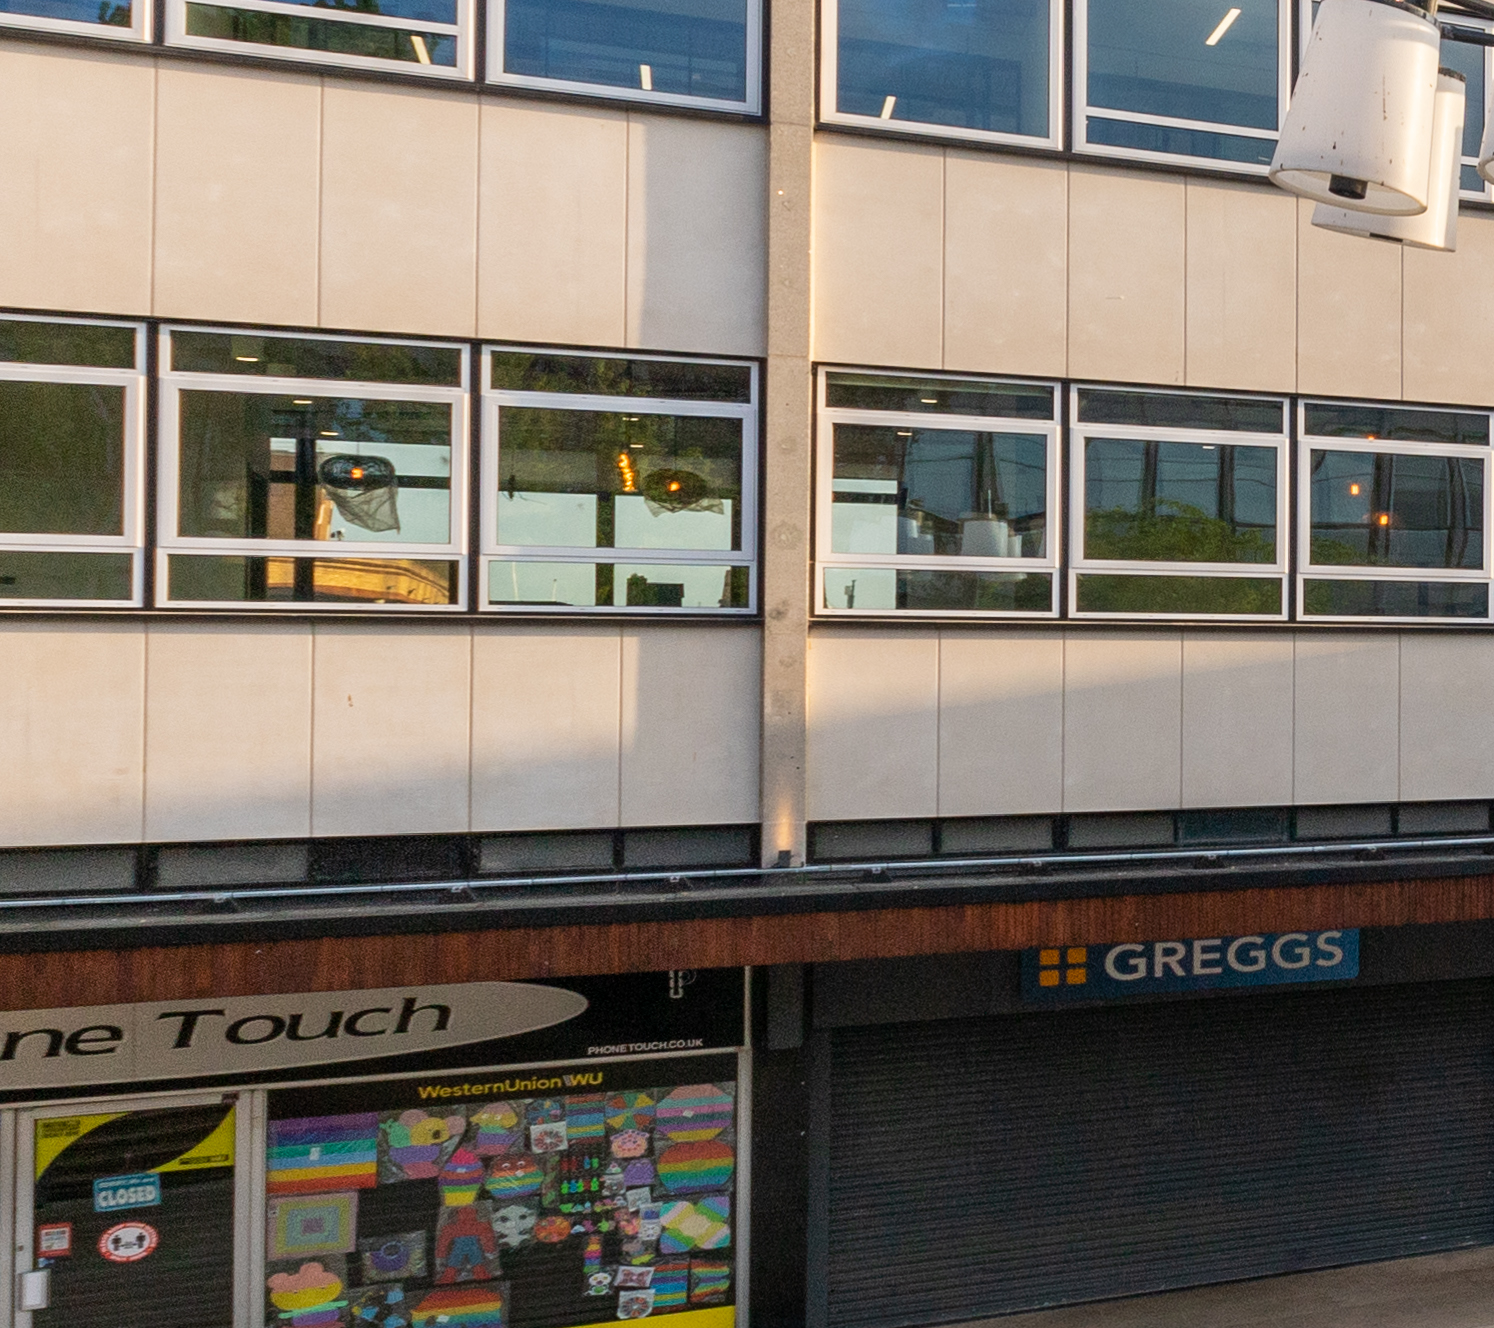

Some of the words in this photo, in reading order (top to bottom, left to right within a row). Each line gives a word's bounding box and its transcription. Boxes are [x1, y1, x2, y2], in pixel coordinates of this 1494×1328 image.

[1104, 931, 1344, 981] GREGGS
[155, 996, 452, 1050] Touch
[100, 1185, 156, 1207] CLOSED
